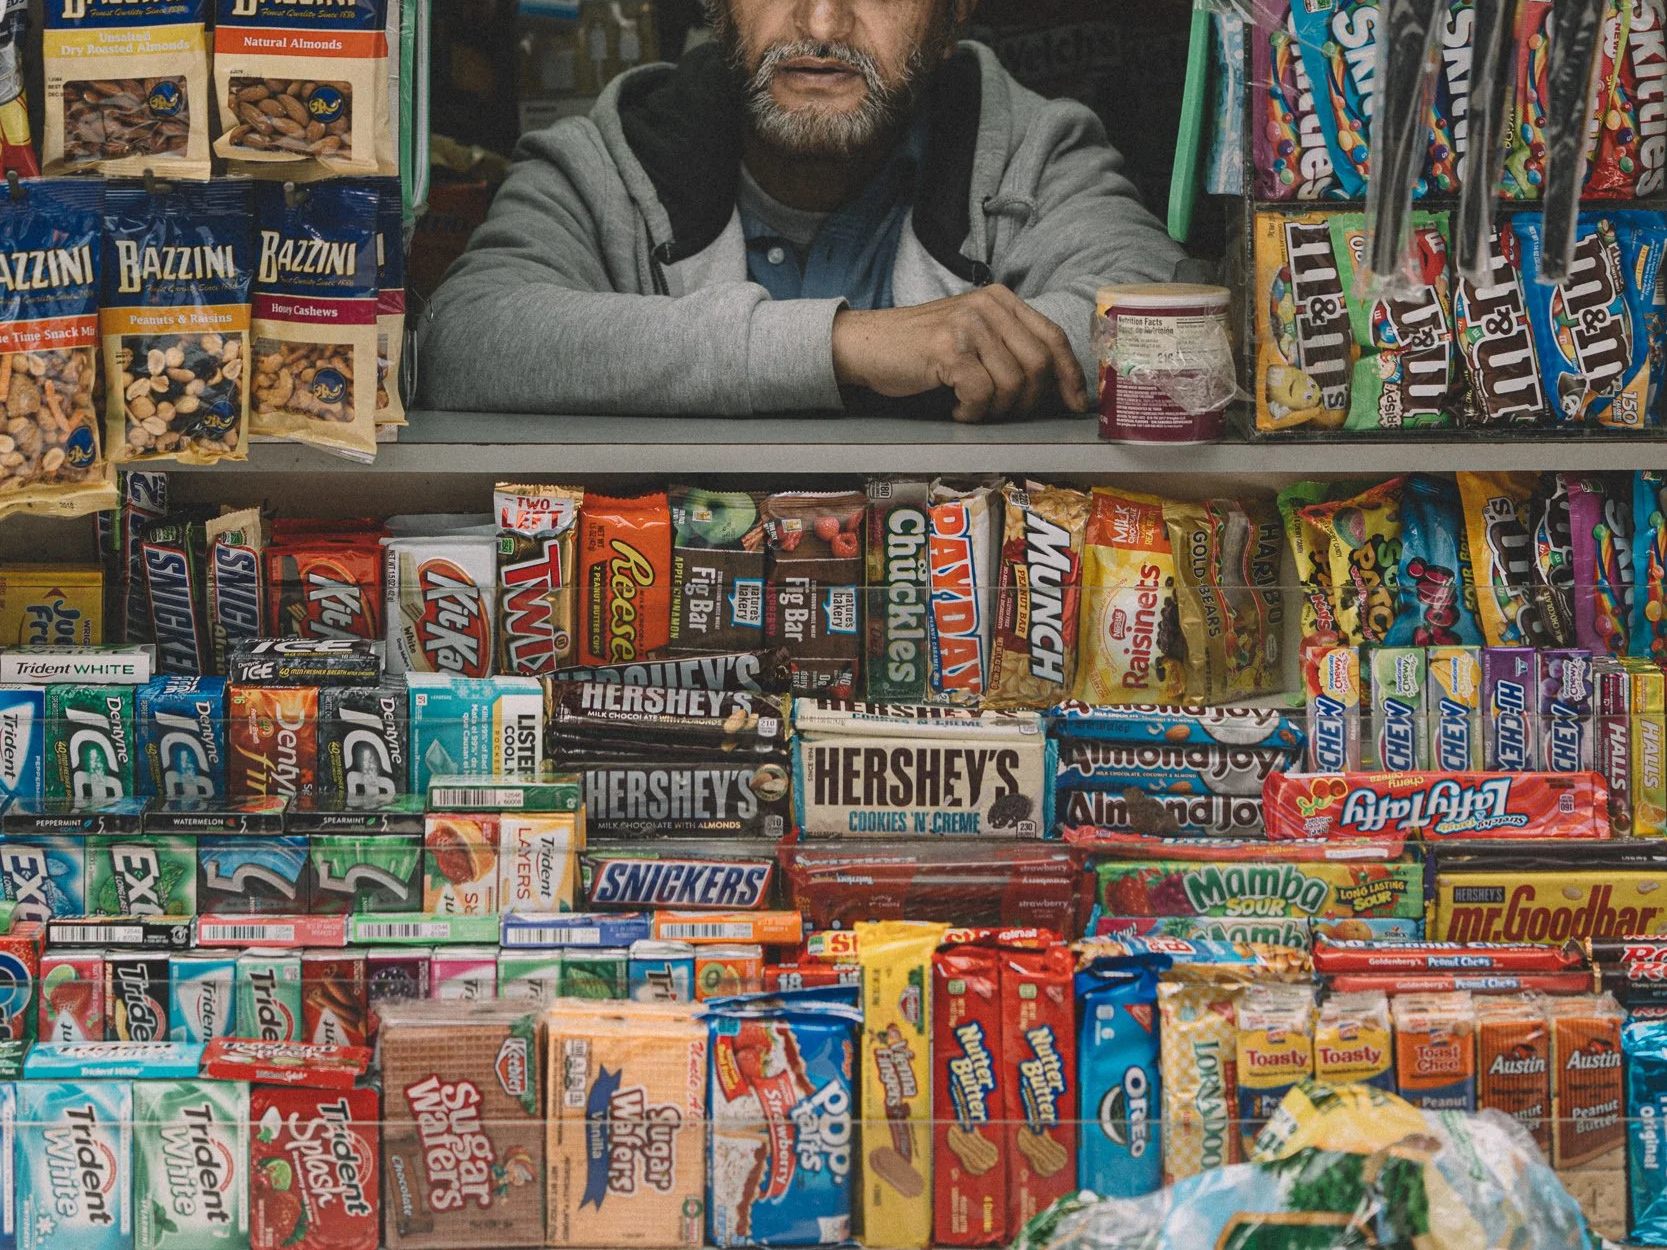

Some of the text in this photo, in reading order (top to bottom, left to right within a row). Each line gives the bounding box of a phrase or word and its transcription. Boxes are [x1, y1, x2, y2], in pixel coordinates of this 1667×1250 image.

[61, 39, 191, 56] Dry Roasted Almonds
[98, 30, 151, 43] Unsalted
[243, 35, 343, 50] Natural Almonds
[116, 239, 237, 295] BAZZINI
[258, 230, 357, 285] BAZZINI
[12, 326, 79, 344] Time Snack
[129, 312, 233, 327] Peanuts Raisins
[293, 305, 339, 319] Cashews
[1144, 318, 1163, 327] Facts
[501, 511, 564, 529] LEFT
[516, 497, 551, 511] TWO
[1111, 504, 1131, 545] MILK
[1127, 506, 1139, 545] CHOCOLATE
[593, 572, 601, 603] PEANUT
[670, 555, 684, 639] APPLE CINNAMON
[684, 565, 716, 634] Fig Bar
[887, 509, 926, 684] Chuckles
[927, 502, 988, 694] PAYDAY
[1024, 510, 1072, 684] MUNCH
[1191, 530, 1221, 639] GOLD-BEARS
[1251, 523, 1284, 626] HARIBO
[502, 540, 563, 672] TWIX
[593, 604, 601, 632] BUTTER
[737, 583, 749, 621] bakery
[778, 576, 810, 643] Fig Bar
[1121, 561, 1161, 690] Raisinets
[16, 661, 135, 676] Trident WHITE
[241, 661, 274, 681] ICE
[593, 634, 601, 655] CUPS
[582, 682, 753, 718] HERSHEY'S
[587, 710, 658, 721] MILK CHOCOLATE
[3, 713, 19, 781] Trident
[106, 696, 129, 764] Dentyne
[195, 700, 219, 764] Dentyne
[380, 697, 402, 764] Dentyne
[504, 725, 515, 762] COOL
[1608, 721, 1628, 791] HALLS
[1640, 719, 1660, 789] HALLS
[585, 769, 758, 821] HERSHEY'S
[814, 746, 1020, 808] HERSHEY'S
[1426, 776, 1512, 826] Laffy
[35, 819, 81, 827] PEPPERMINT
[173, 818, 224, 826] WATERMELON
[597, 821, 619, 829] MILK
[698, 821, 741, 830] ALMONDS
[848, 810, 981, 834] COOKIES CREME
[1340, 788, 1427, 832] Taffy
[517, 827, 533, 901] LAYERS
[539, 836, 555, 899] Trident
[599, 862, 768, 906] SNICKERS
[1183, 862, 1330, 915] Mamba
[1225, 898, 1287, 917] SOUR
[1339, 886, 1368, 900] LONG
[1455, 888, 1503, 901] HERSHEY'S
[507, 1039, 527, 1094] Keebler
[955, 1022, 996, 1091] Nutter
[1025, 1026, 1067, 1094] Nutter
[1246, 1049, 1309, 1067] Toasty
[1318, 1046, 1382, 1065] Toasty
[1415, 1045, 1461, 1059] Toast
[1488, 1054, 1546, 1075] Austin
[1565, 1050, 1622, 1070] Austin
[950, 1058, 988, 1125] Butter
[1019, 1060, 1058, 1126] Butter
[1124, 1066, 1148, 1158] OREO
[1422, 1096, 1467, 1108] Peanut
[1571, 1099, 1619, 1119] Peanut
[406, 1075, 466, 1211] Wafers
[441, 1081, 491, 1207] Sugar
[610, 1086, 644, 1195] Wafers
[646, 1104, 683, 1193] Sugar
[762, 1087, 795, 1186] Strawberry
[1576, 1114, 1619, 1134] Butter
[1639, 1105, 1659, 1169] Original
[43, 1125, 79, 1217] White
[65, 1104, 113, 1226] Trident
[159, 1125, 196, 1217] White
[183, 1103, 231, 1224] Trident
[286, 1110, 338, 1209] Splash
[317, 1097, 370, 1217] Trident
